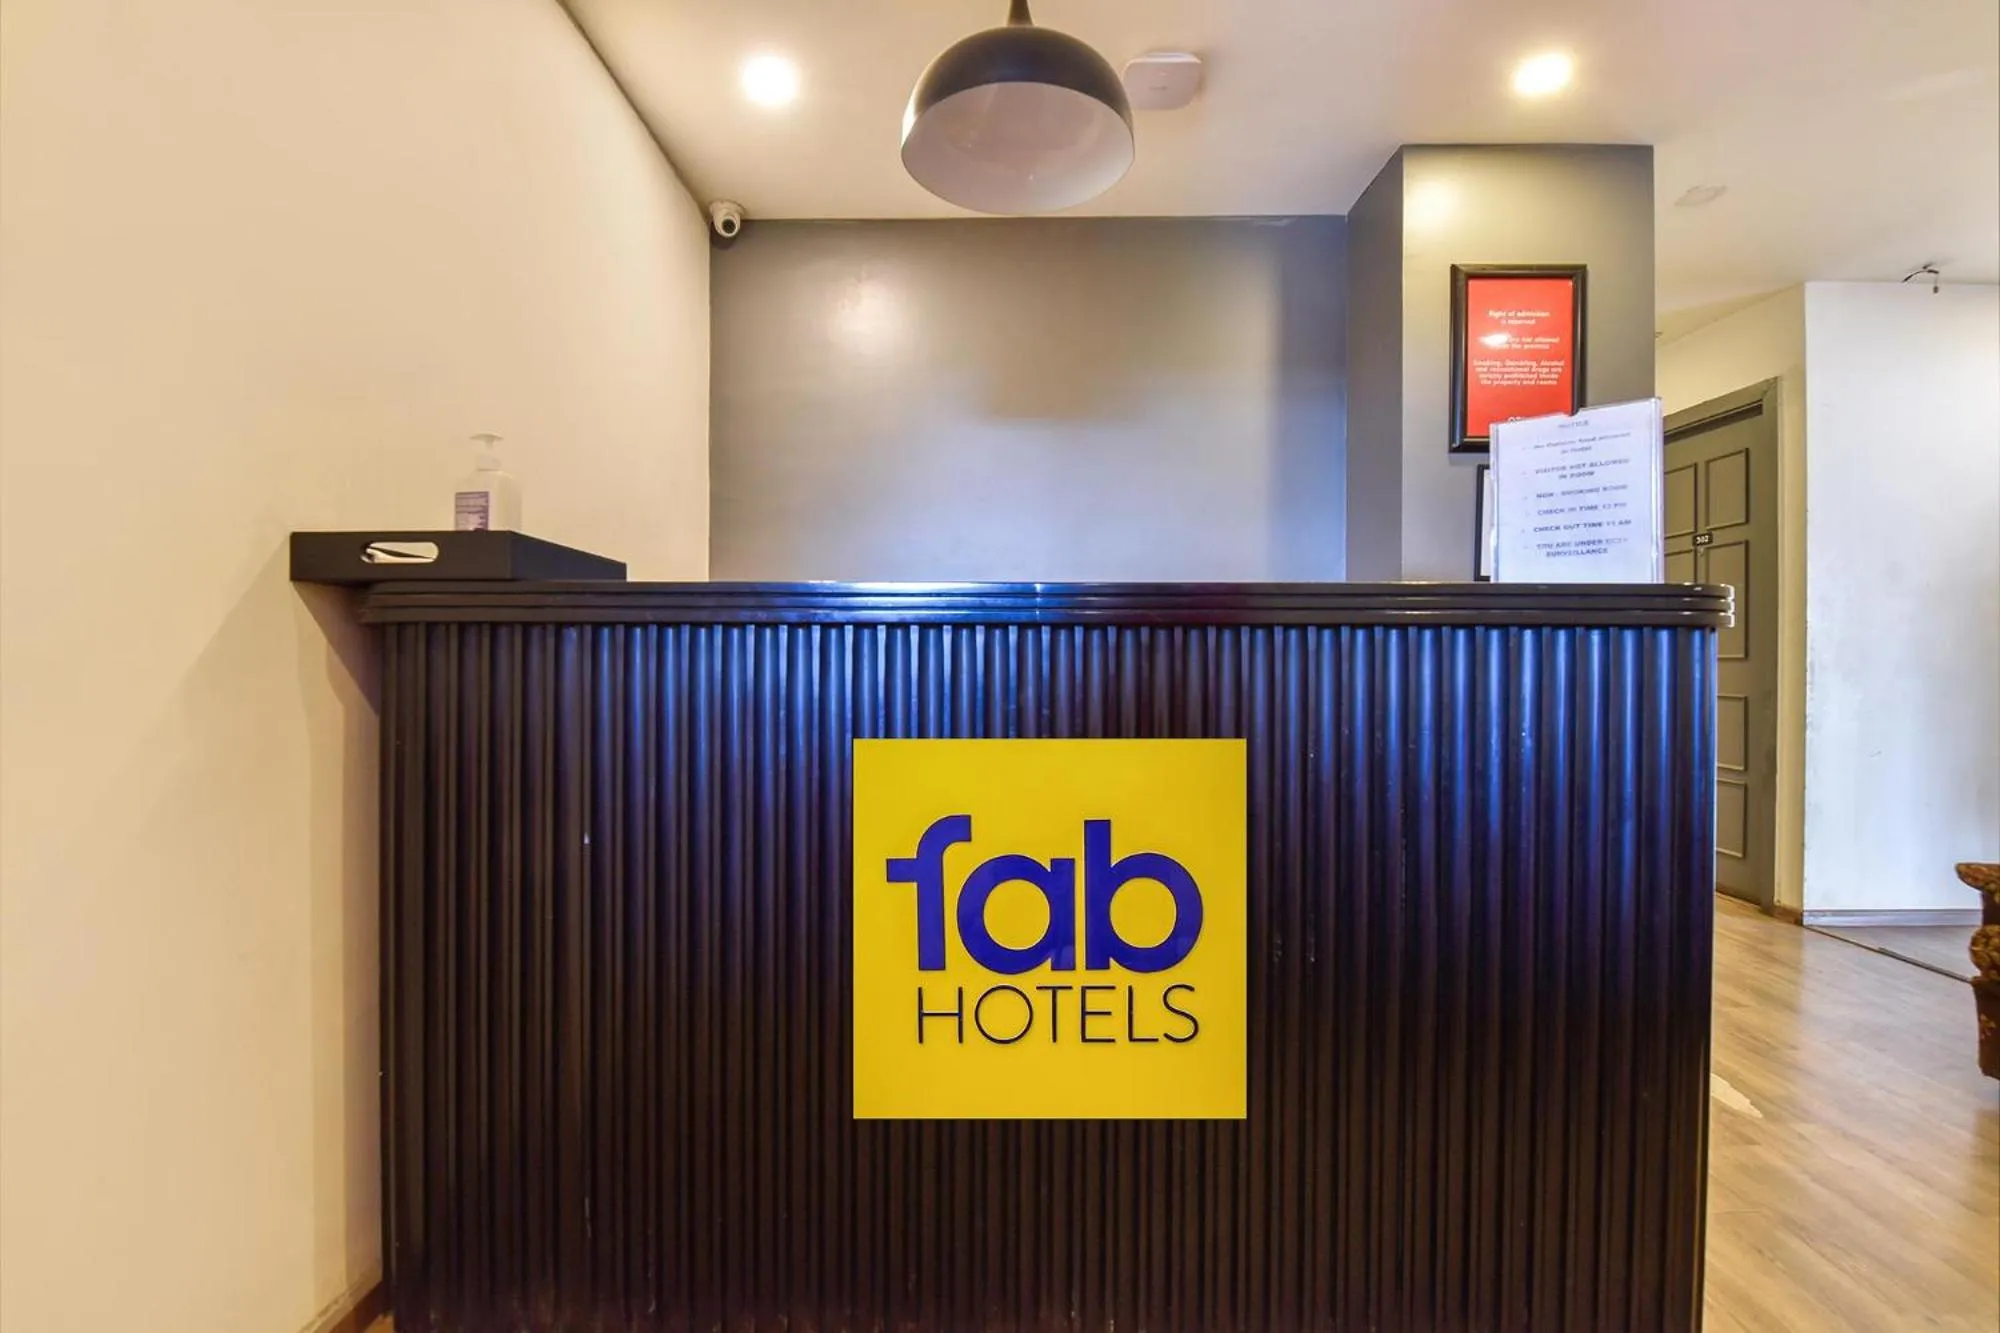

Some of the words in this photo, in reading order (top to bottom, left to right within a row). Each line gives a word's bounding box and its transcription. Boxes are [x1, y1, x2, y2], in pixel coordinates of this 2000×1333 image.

[1488, 310, 1505, 319] Right
[1588, 458, 1629, 468] ALLOWED
[886, 814, 1204, 975] fab
[918, 984, 1200, 1044] HOTELS
